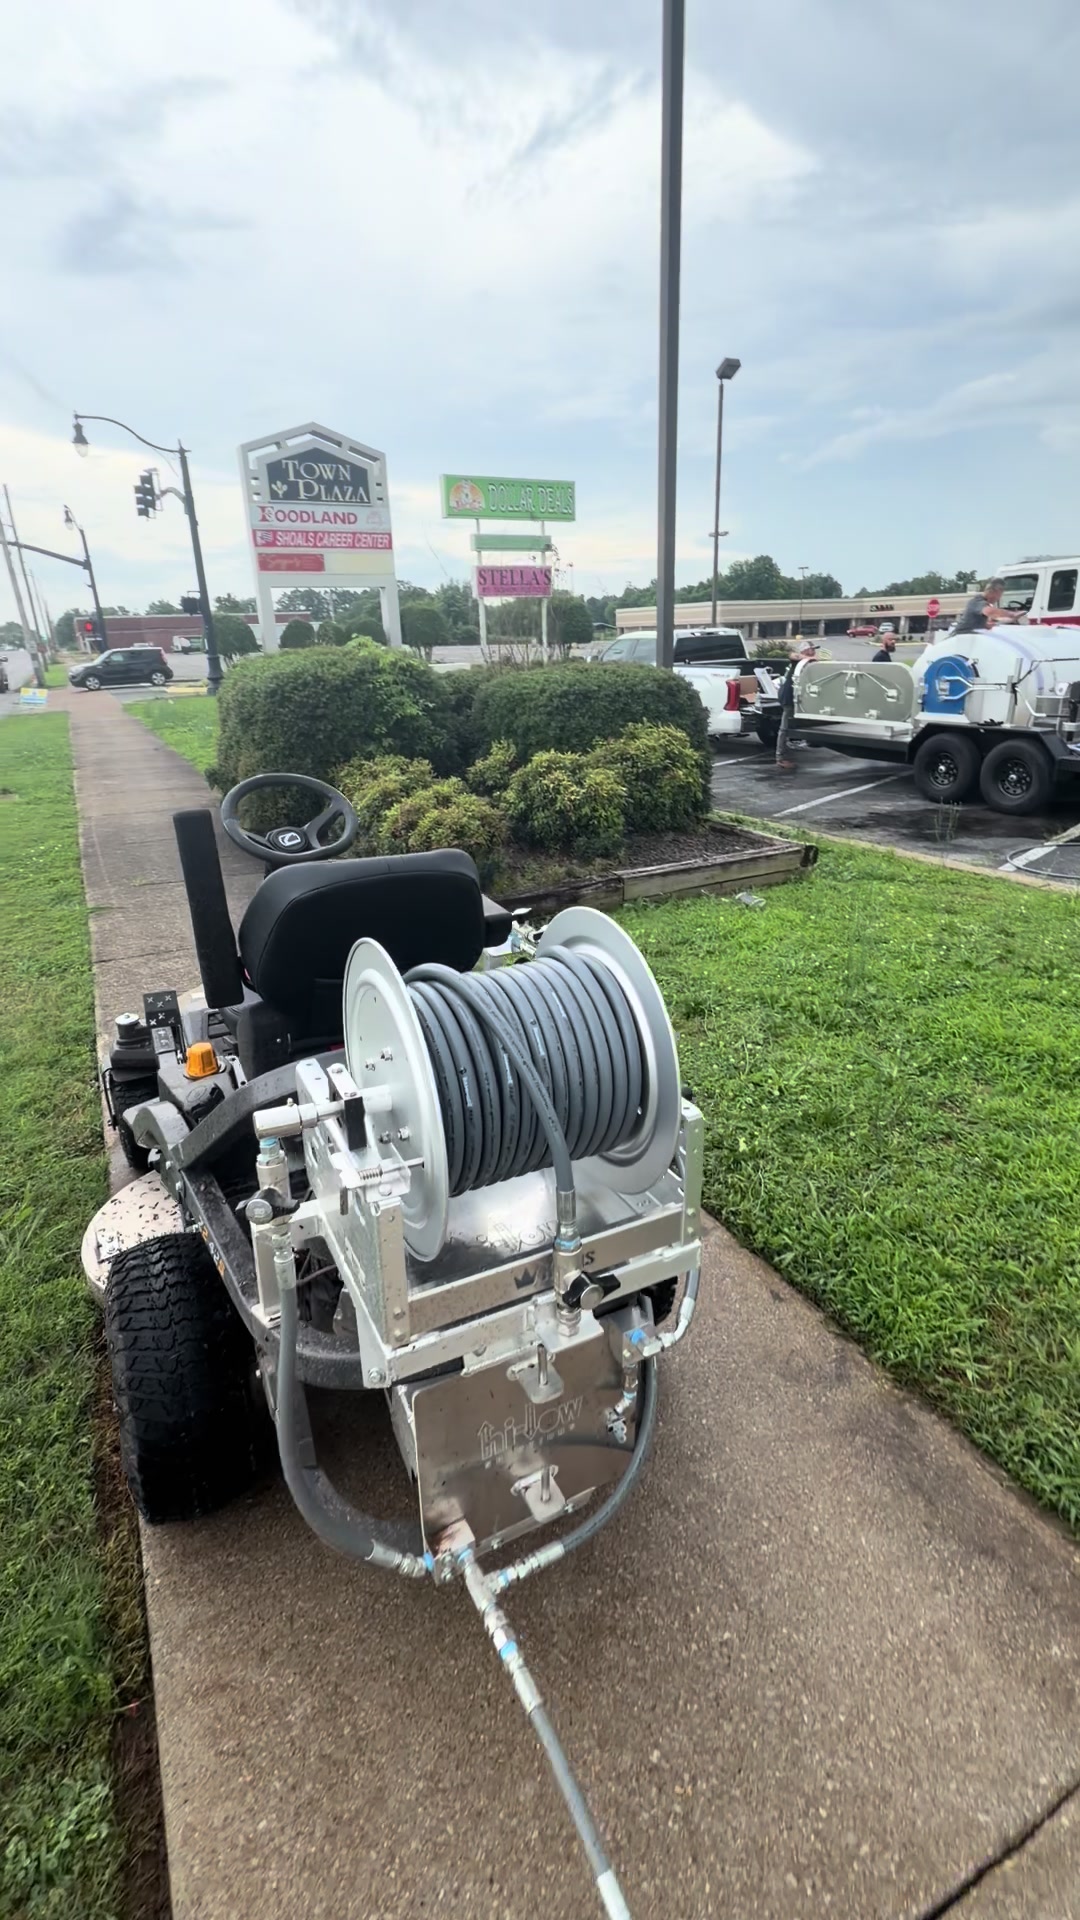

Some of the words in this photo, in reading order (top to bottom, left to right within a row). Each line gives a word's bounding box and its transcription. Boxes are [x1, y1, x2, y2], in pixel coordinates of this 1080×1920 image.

[281, 459, 351, 482] TOWN
[294, 478, 370, 502] PLAZA
[488, 483, 535, 512] DOLLAR
[537, 487, 573, 515] DEALS
[258, 505, 358, 525] FOODLAND
[275, 531, 316, 547] SHOALS
[316, 532, 353, 548] CAREER
[354, 533, 390, 548] CENTER
[478, 569, 552, 586] STELLA'S
